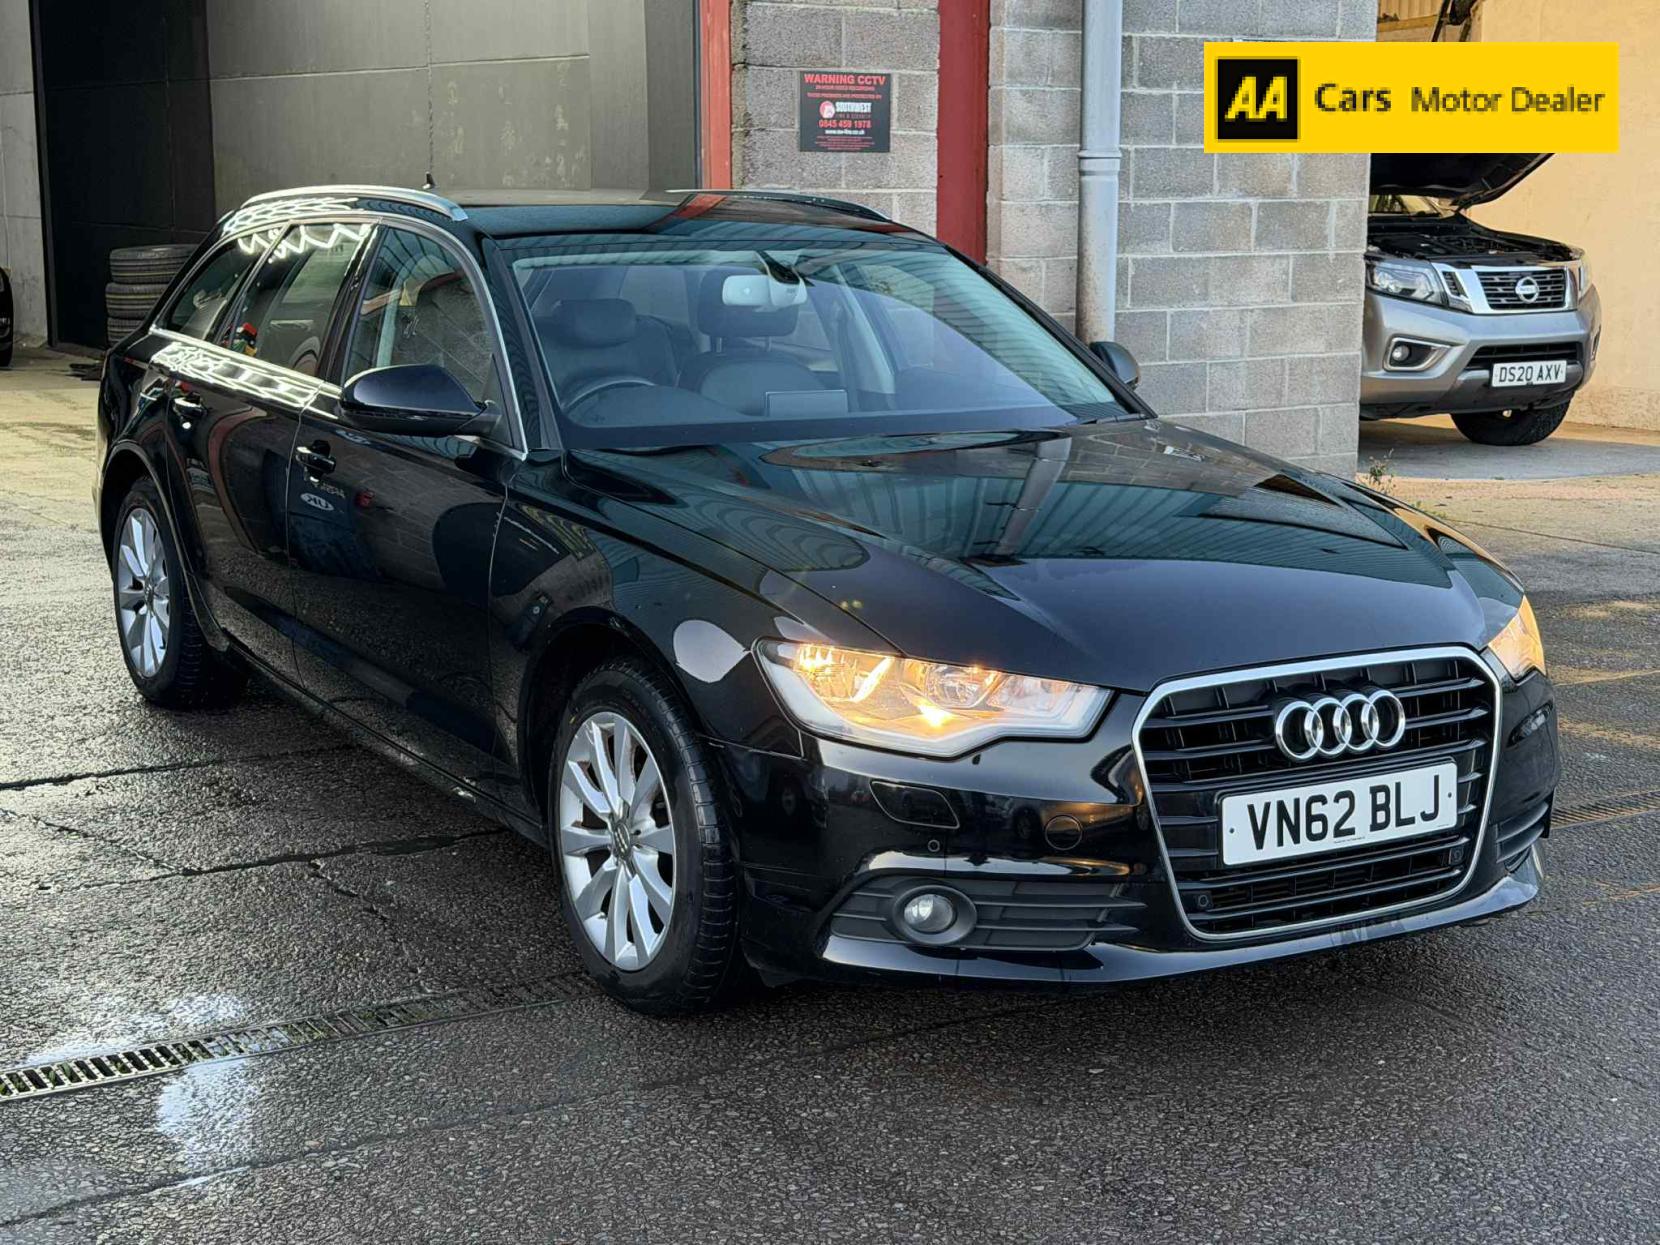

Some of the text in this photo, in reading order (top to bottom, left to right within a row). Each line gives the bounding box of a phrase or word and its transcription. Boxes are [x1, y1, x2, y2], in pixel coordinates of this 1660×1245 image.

[804, 74, 886, 85] WARNING CCTV
[1499, 364, 1561, 382] DS20 AXV
[1247, 774, 1440, 850] VN62 BLJ
